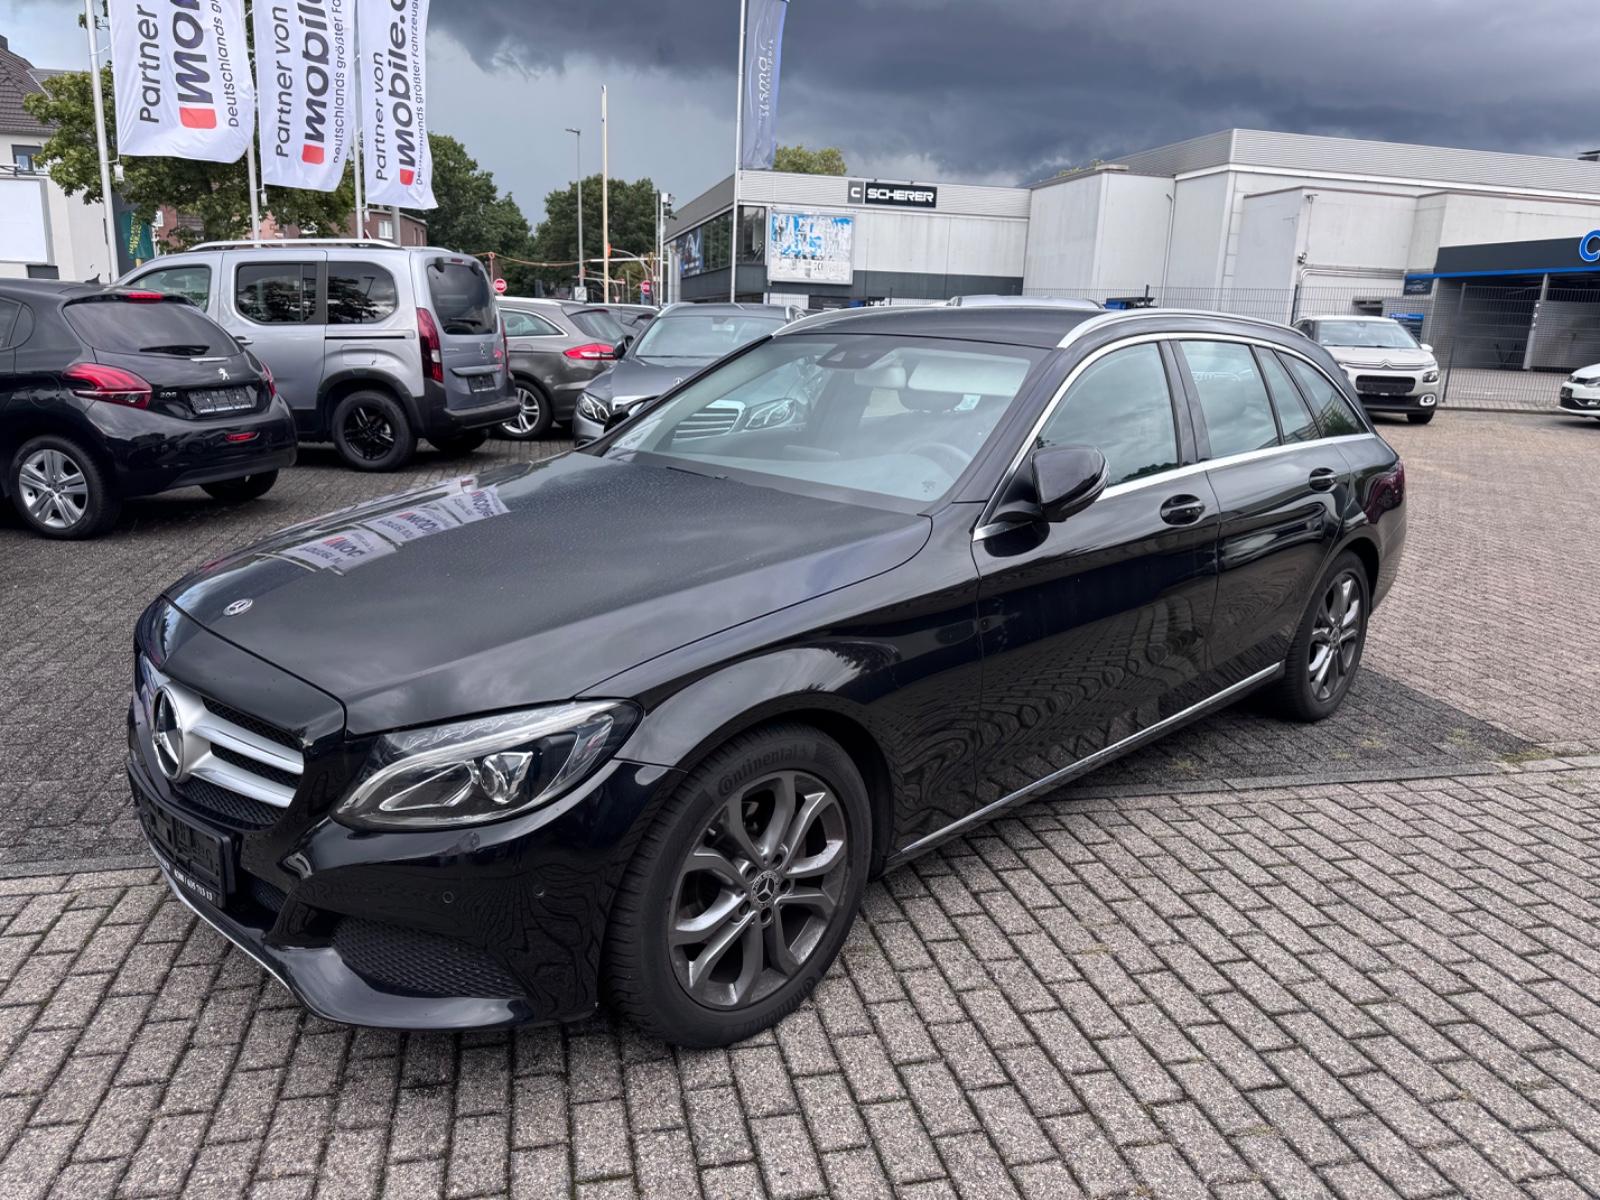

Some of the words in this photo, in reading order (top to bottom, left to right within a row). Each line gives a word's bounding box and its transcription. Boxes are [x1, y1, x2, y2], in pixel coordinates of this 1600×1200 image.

[272, 6, 291, 54] von
[333, 16, 346, 69] größter
[136, 4, 161, 124] Partner
[213, 16, 239, 127] Deutschlands
[297, 0, 330, 143] mobil
[373, 52, 384, 92] von
[413, 61, 424, 104] größter
[275, 60, 293, 157] Partner
[375, 98, 388, 181] Partner
[850, 187, 861, 198] C
[867, 187, 934, 202] SCHERER
[718, 745, 797, 796] Continental
